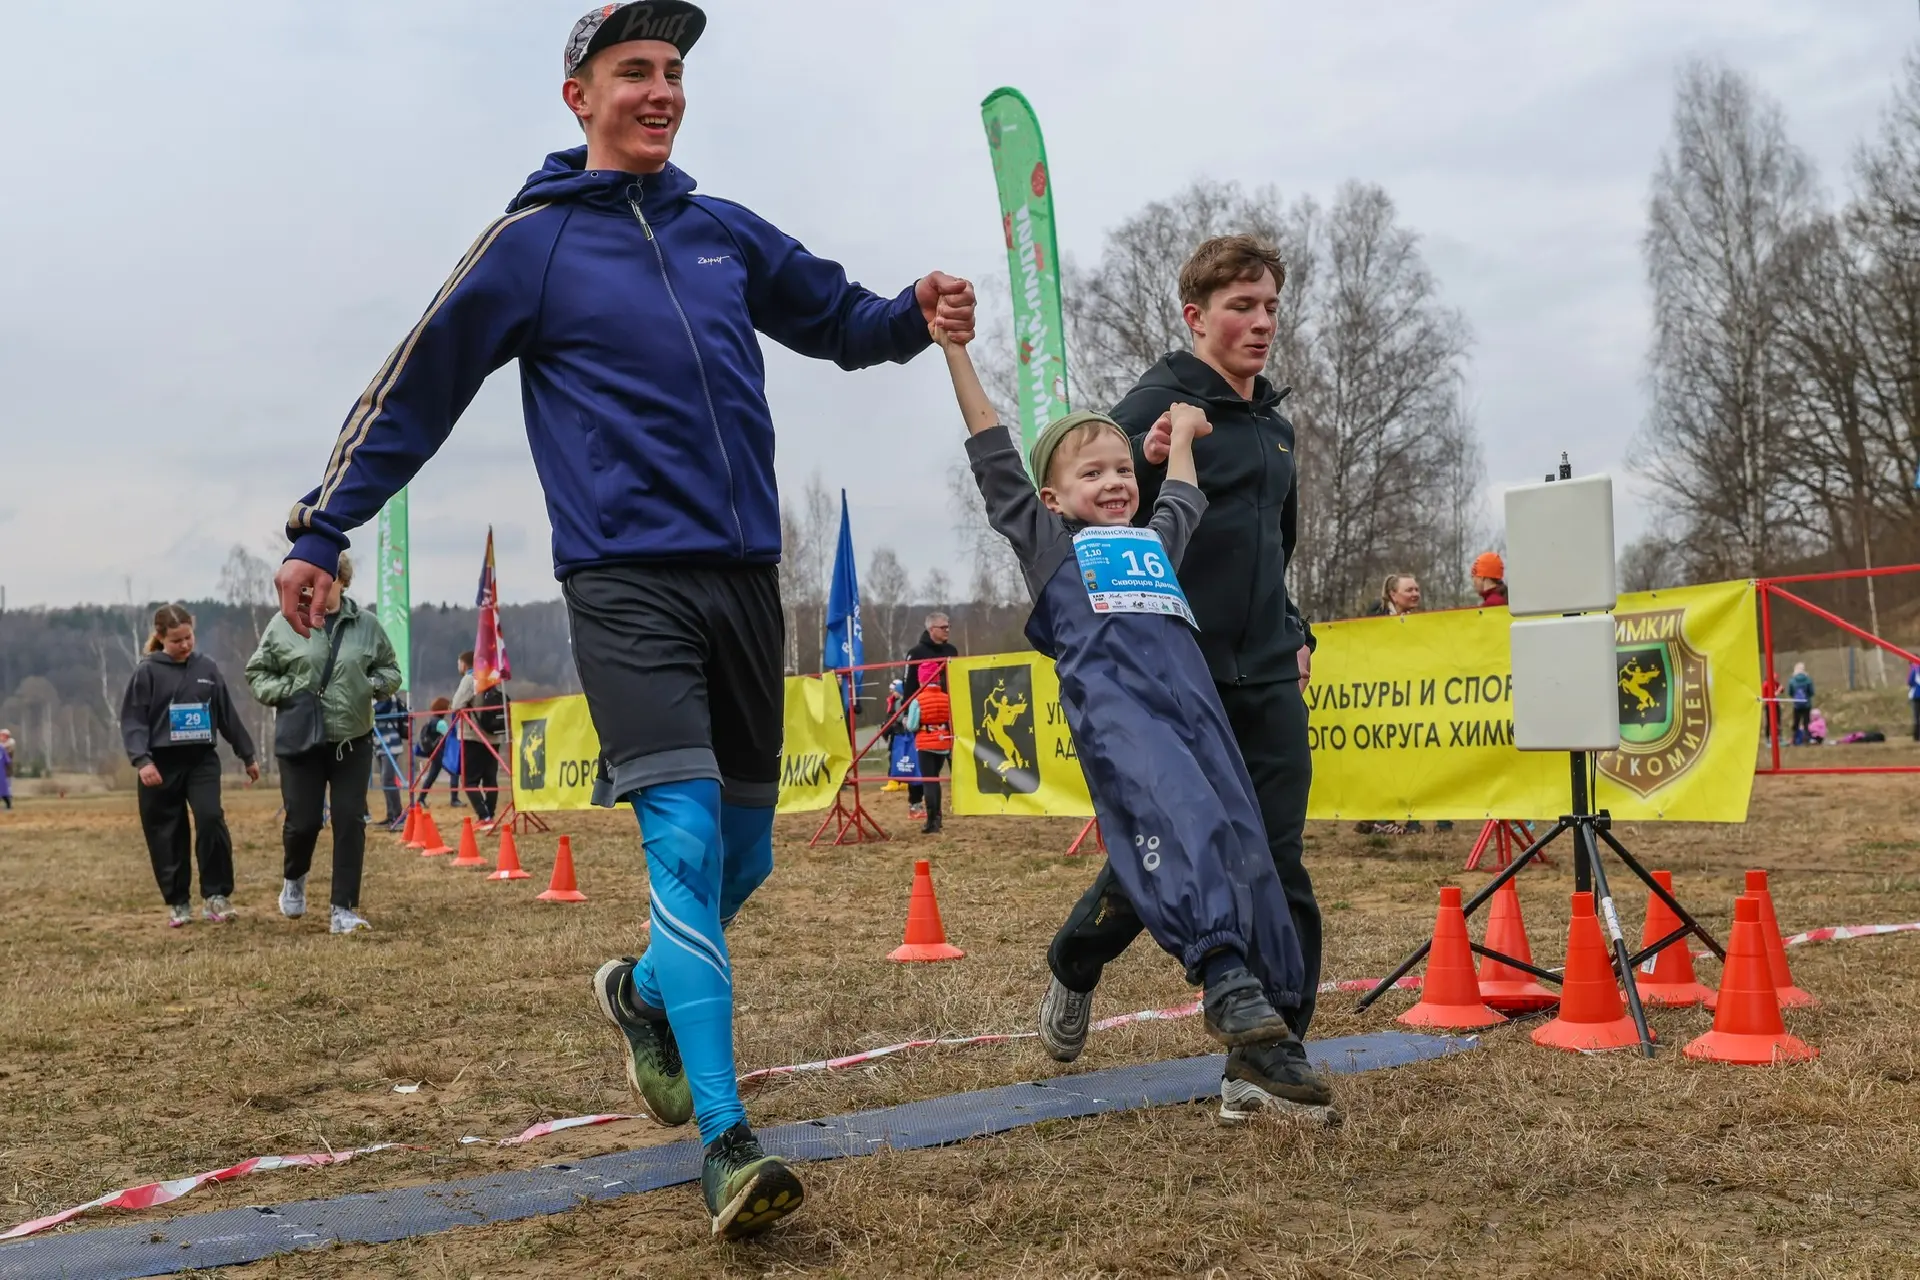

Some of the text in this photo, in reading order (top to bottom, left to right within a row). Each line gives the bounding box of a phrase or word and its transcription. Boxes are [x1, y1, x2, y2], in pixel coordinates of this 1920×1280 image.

[1121, 550, 1165, 578] 16
[1111, 578, 1153, 587] Скворцов
[1309, 680, 1410, 710] УЛЬТУРЫ
[1420, 679, 1435, 706] И
[184, 712, 201, 726] 29
[1354, 722, 1441, 749] ОКРУГА
